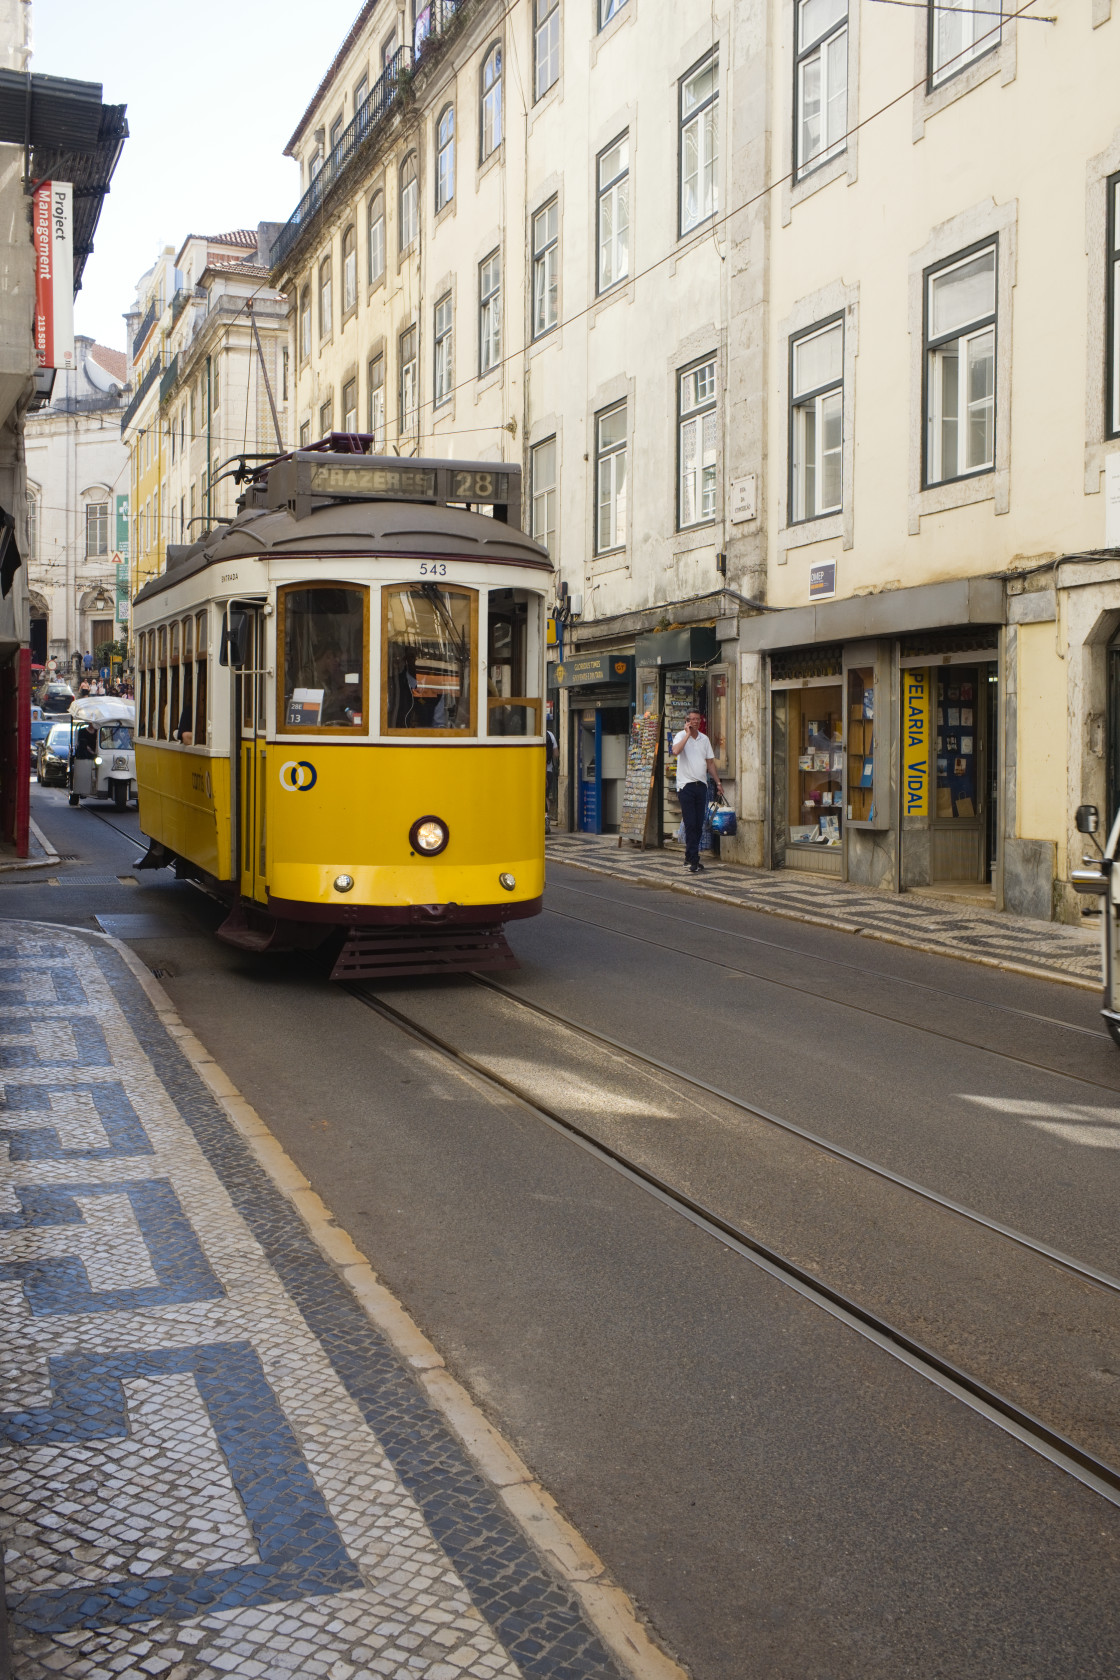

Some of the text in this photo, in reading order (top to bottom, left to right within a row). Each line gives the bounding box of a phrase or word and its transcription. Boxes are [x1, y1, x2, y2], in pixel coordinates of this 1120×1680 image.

[53, 192, 67, 241] Project
[36, 190, 52, 280] Management
[38, 315, 46, 331] 213
[314, 468, 428, 489] PRAZERES
[456, 472, 493, 496] 28
[419, 563, 447, 576] 543
[290, 714, 301, 723] 13
[907, 760, 927, 814] VIDAL
